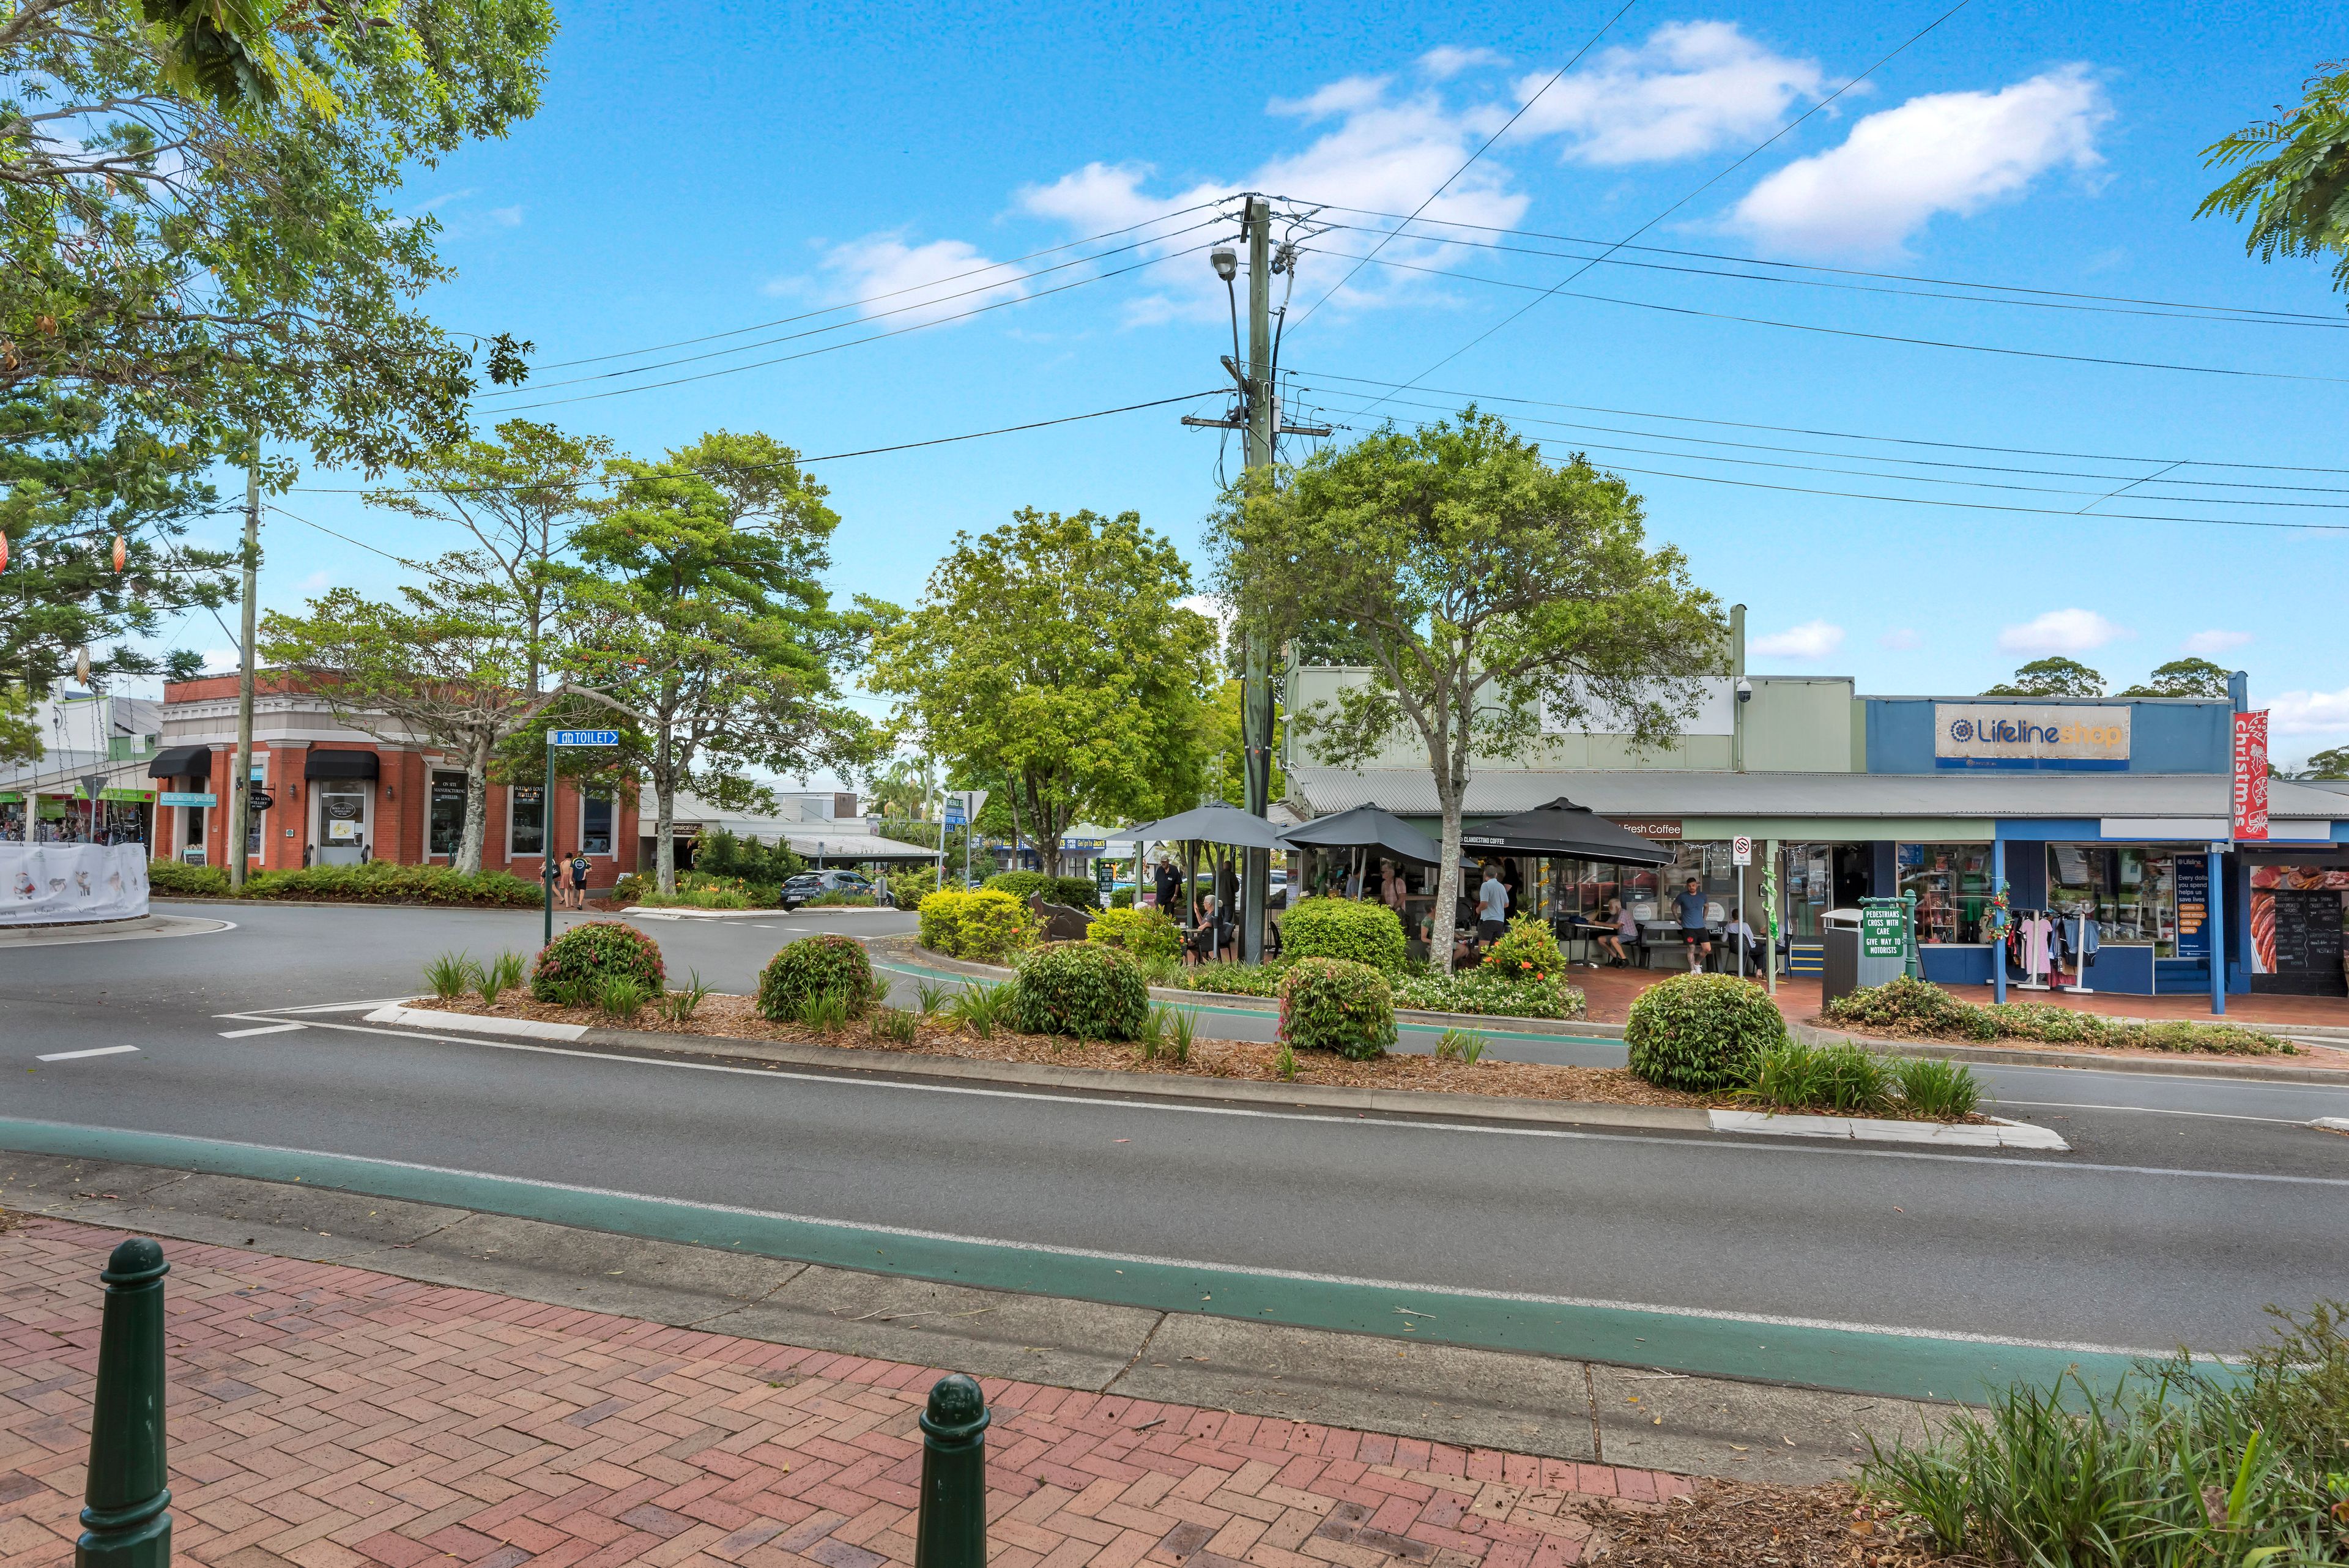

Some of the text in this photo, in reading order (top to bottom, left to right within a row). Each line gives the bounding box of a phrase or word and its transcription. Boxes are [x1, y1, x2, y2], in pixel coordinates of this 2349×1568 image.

[575, 732, 608, 743] TOILET
[1978, 719, 2122, 749] Lifeline shop
[2235, 720, 2251, 827] christmas
[947, 798, 959, 807] EMERALD
[1624, 824, 1681, 834] Fresh Coffee
